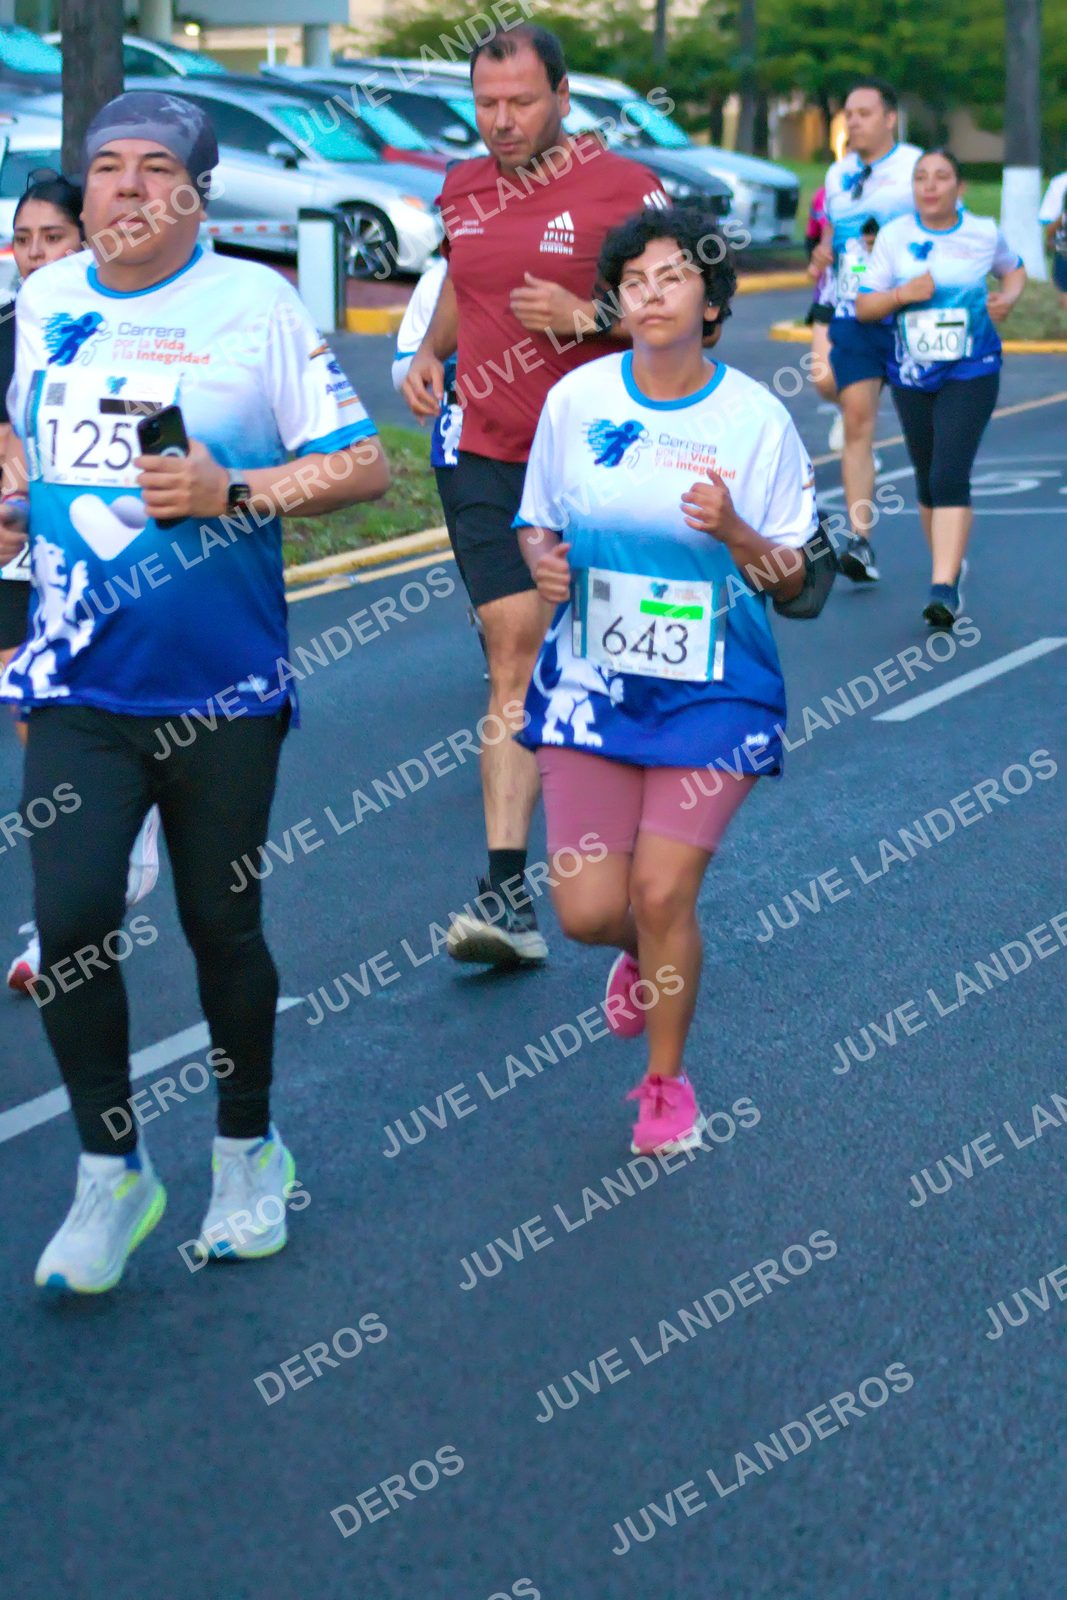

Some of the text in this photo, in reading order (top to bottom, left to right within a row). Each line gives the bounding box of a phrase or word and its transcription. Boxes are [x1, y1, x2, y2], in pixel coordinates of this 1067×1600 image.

[841, 275, 861, 293] 62
[118, 322, 186, 338] Carrera
[154, 339, 186, 351] Vida
[917, 331, 960, 353] 640
[137, 349, 210, 365] Integridad
[47, 419, 133, 471] 125
[658, 433, 717, 455] Carrera
[690, 452, 716, 465] Vida
[676, 460, 736, 480] Integdad
[602, 616, 688, 664] 643
